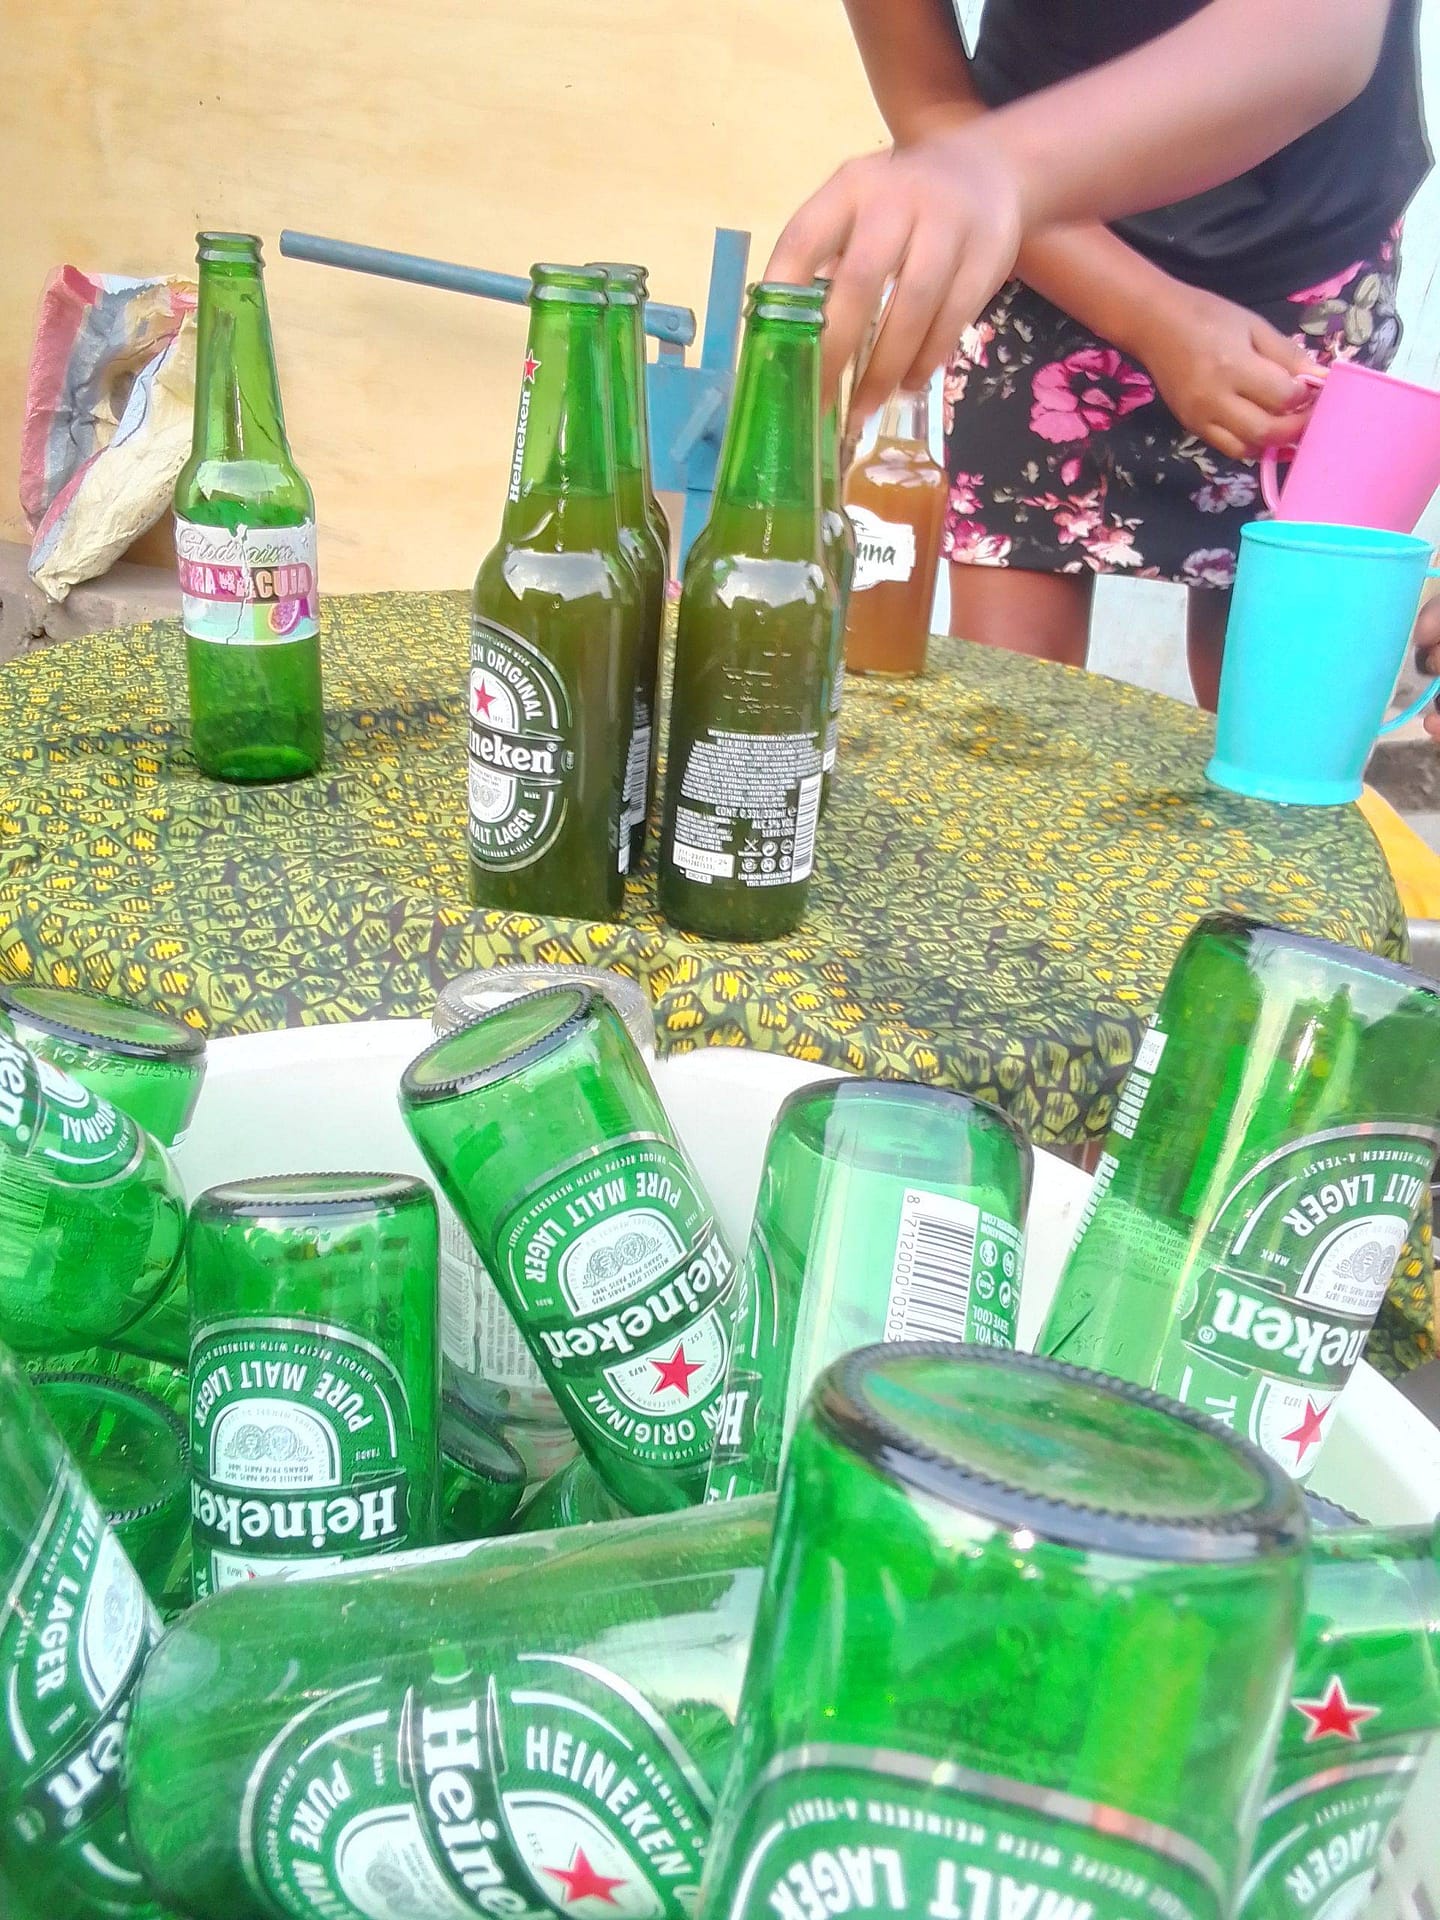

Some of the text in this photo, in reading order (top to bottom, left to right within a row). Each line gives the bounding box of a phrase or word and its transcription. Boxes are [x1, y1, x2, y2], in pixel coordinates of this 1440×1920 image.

[857, 541, 896, 566] nna
[487, 649, 544, 720] ORIGINAL
[469, 730, 556, 774] neken
[494, 808, 536, 846] LAGER
[576, 1166, 601, 1184] WITH
[1301, 1154, 1356, 1179] A-YEAST
[1361, 1150, 1413, 1163] HEINEKEN
[523, 1171, 682, 1283] PURE MALT LAGER
[1281, 1173, 1375, 1237] LAGER
[895, 1218, 918, 1286] 712000
[1259, 1249, 1290, 1266] MARK
[540, 1232, 731, 1362] Heineken
[1211, 1288, 1368, 1375] neken
[240, 1360, 308, 1392] MALT
[313, 1372, 374, 1433] PURE
[586, 1388, 697, 1446] ORIGINAL
[190, 1477, 397, 1549] Heineken
[35, 1575, 81, 1700] LAGER
[290, 1759, 353, 1853] PURE
[422, 1700, 546, 1920] Heine
[526, 1725, 693, 1876] HEINEKEN
[867, 1801, 987, 1847] HEINEKEN
[996, 1832, 1061, 1867] WITH
[1285, 1820, 1379, 1904] LAGER
[767, 1846, 904, 1920] LAGER
[927, 1859, 1094, 1920] MALT
